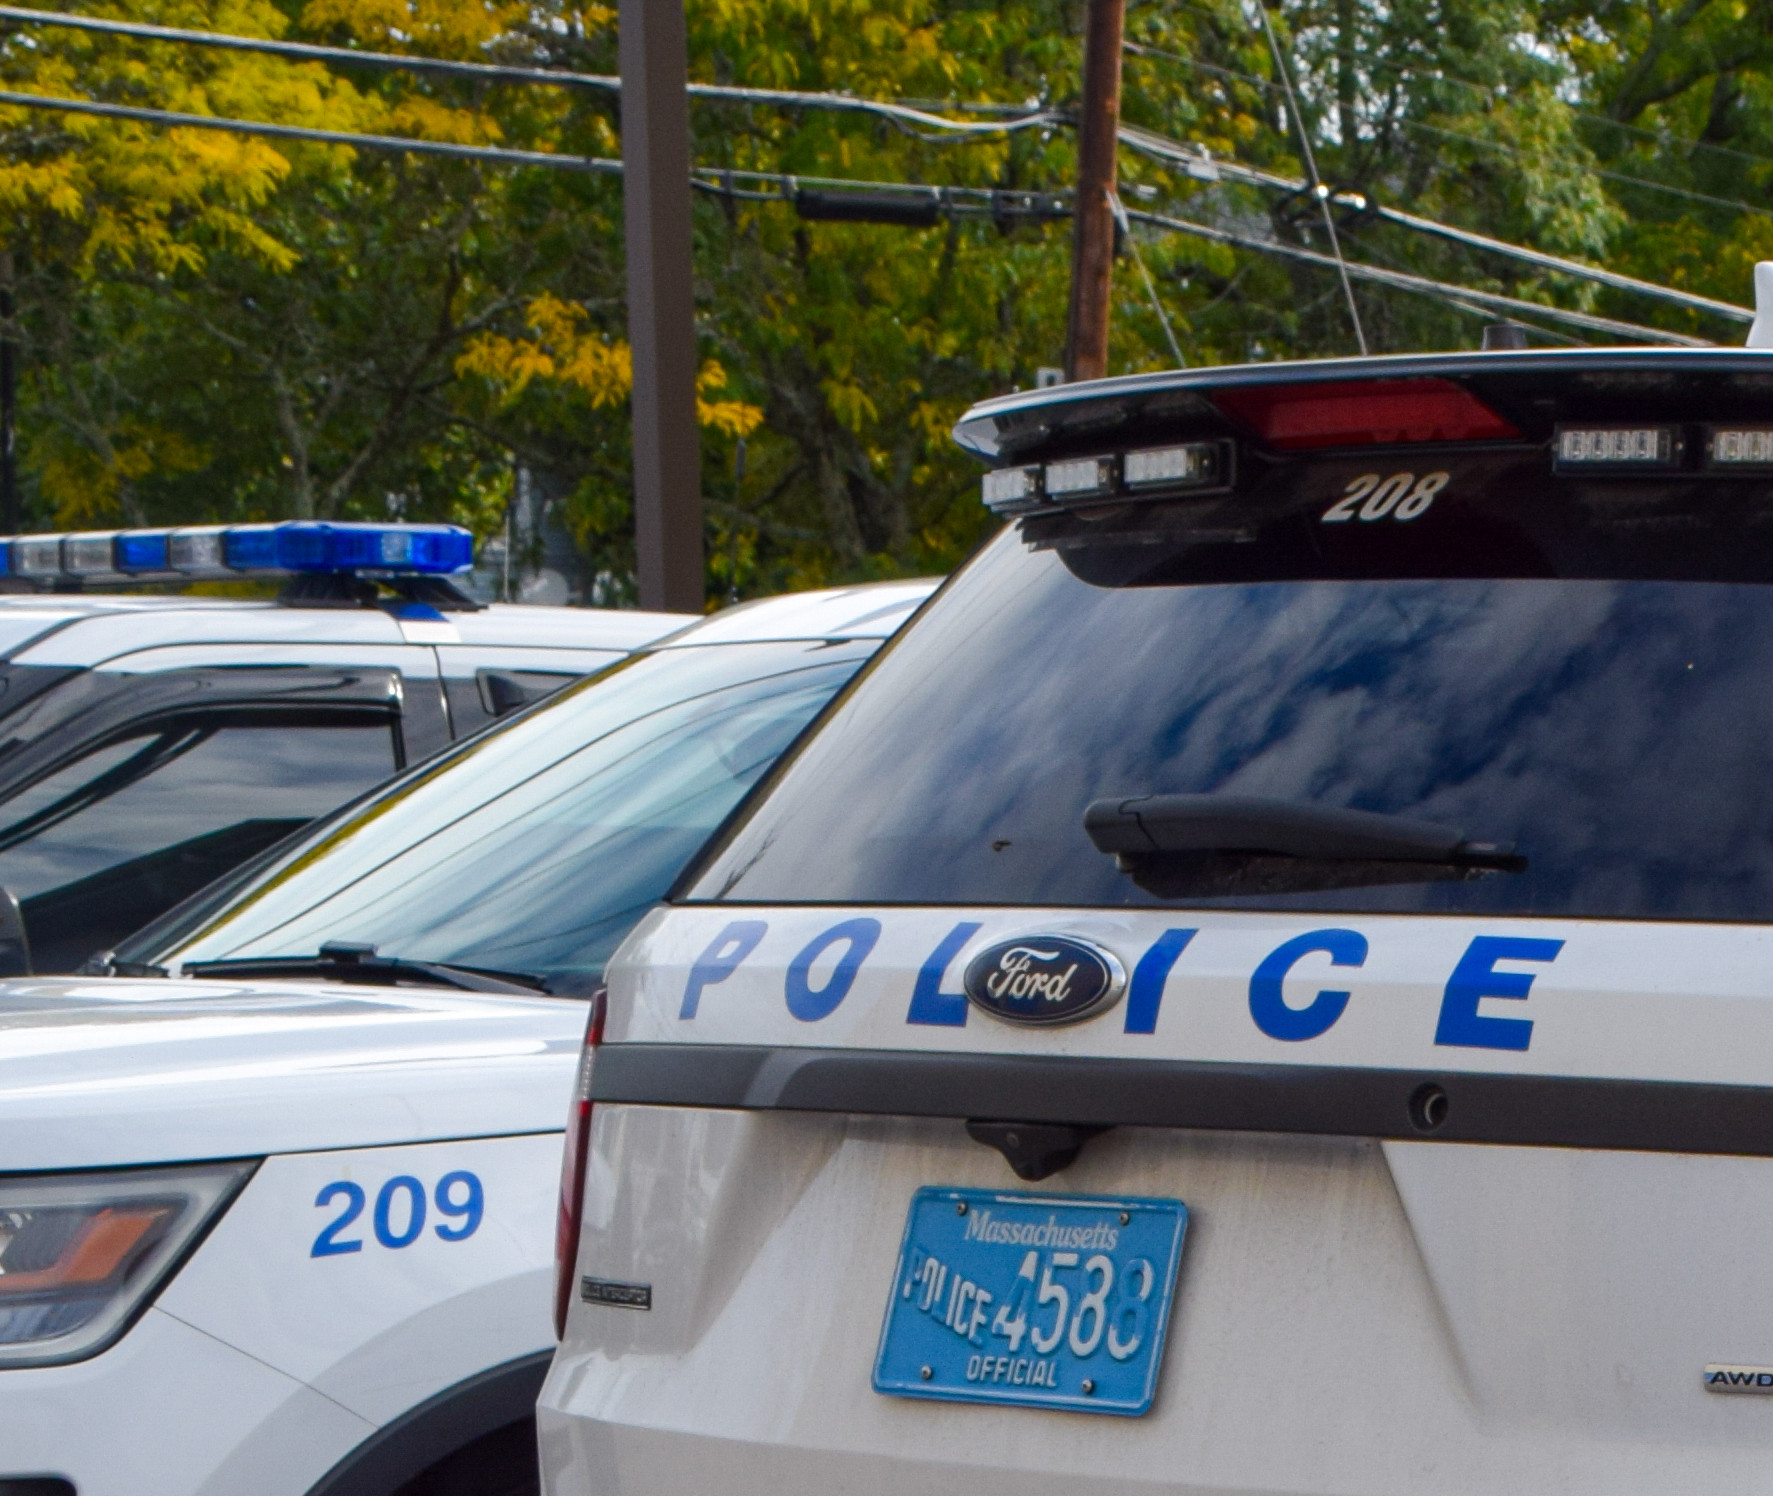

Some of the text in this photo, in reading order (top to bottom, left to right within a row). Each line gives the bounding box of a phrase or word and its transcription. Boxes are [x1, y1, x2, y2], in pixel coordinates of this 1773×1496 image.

[1323, 471, 1450, 523] 208
[678, 916, 1567, 1052] POLICE
[986, 946, 1075, 1004] Ford
[310, 1169, 484, 1258] 209
[963, 1209, 1121, 1251] Massachusetts
[903, 1246, 993, 1349] POLICE
[966, 1355, 1058, 1388] OFFICIAL
